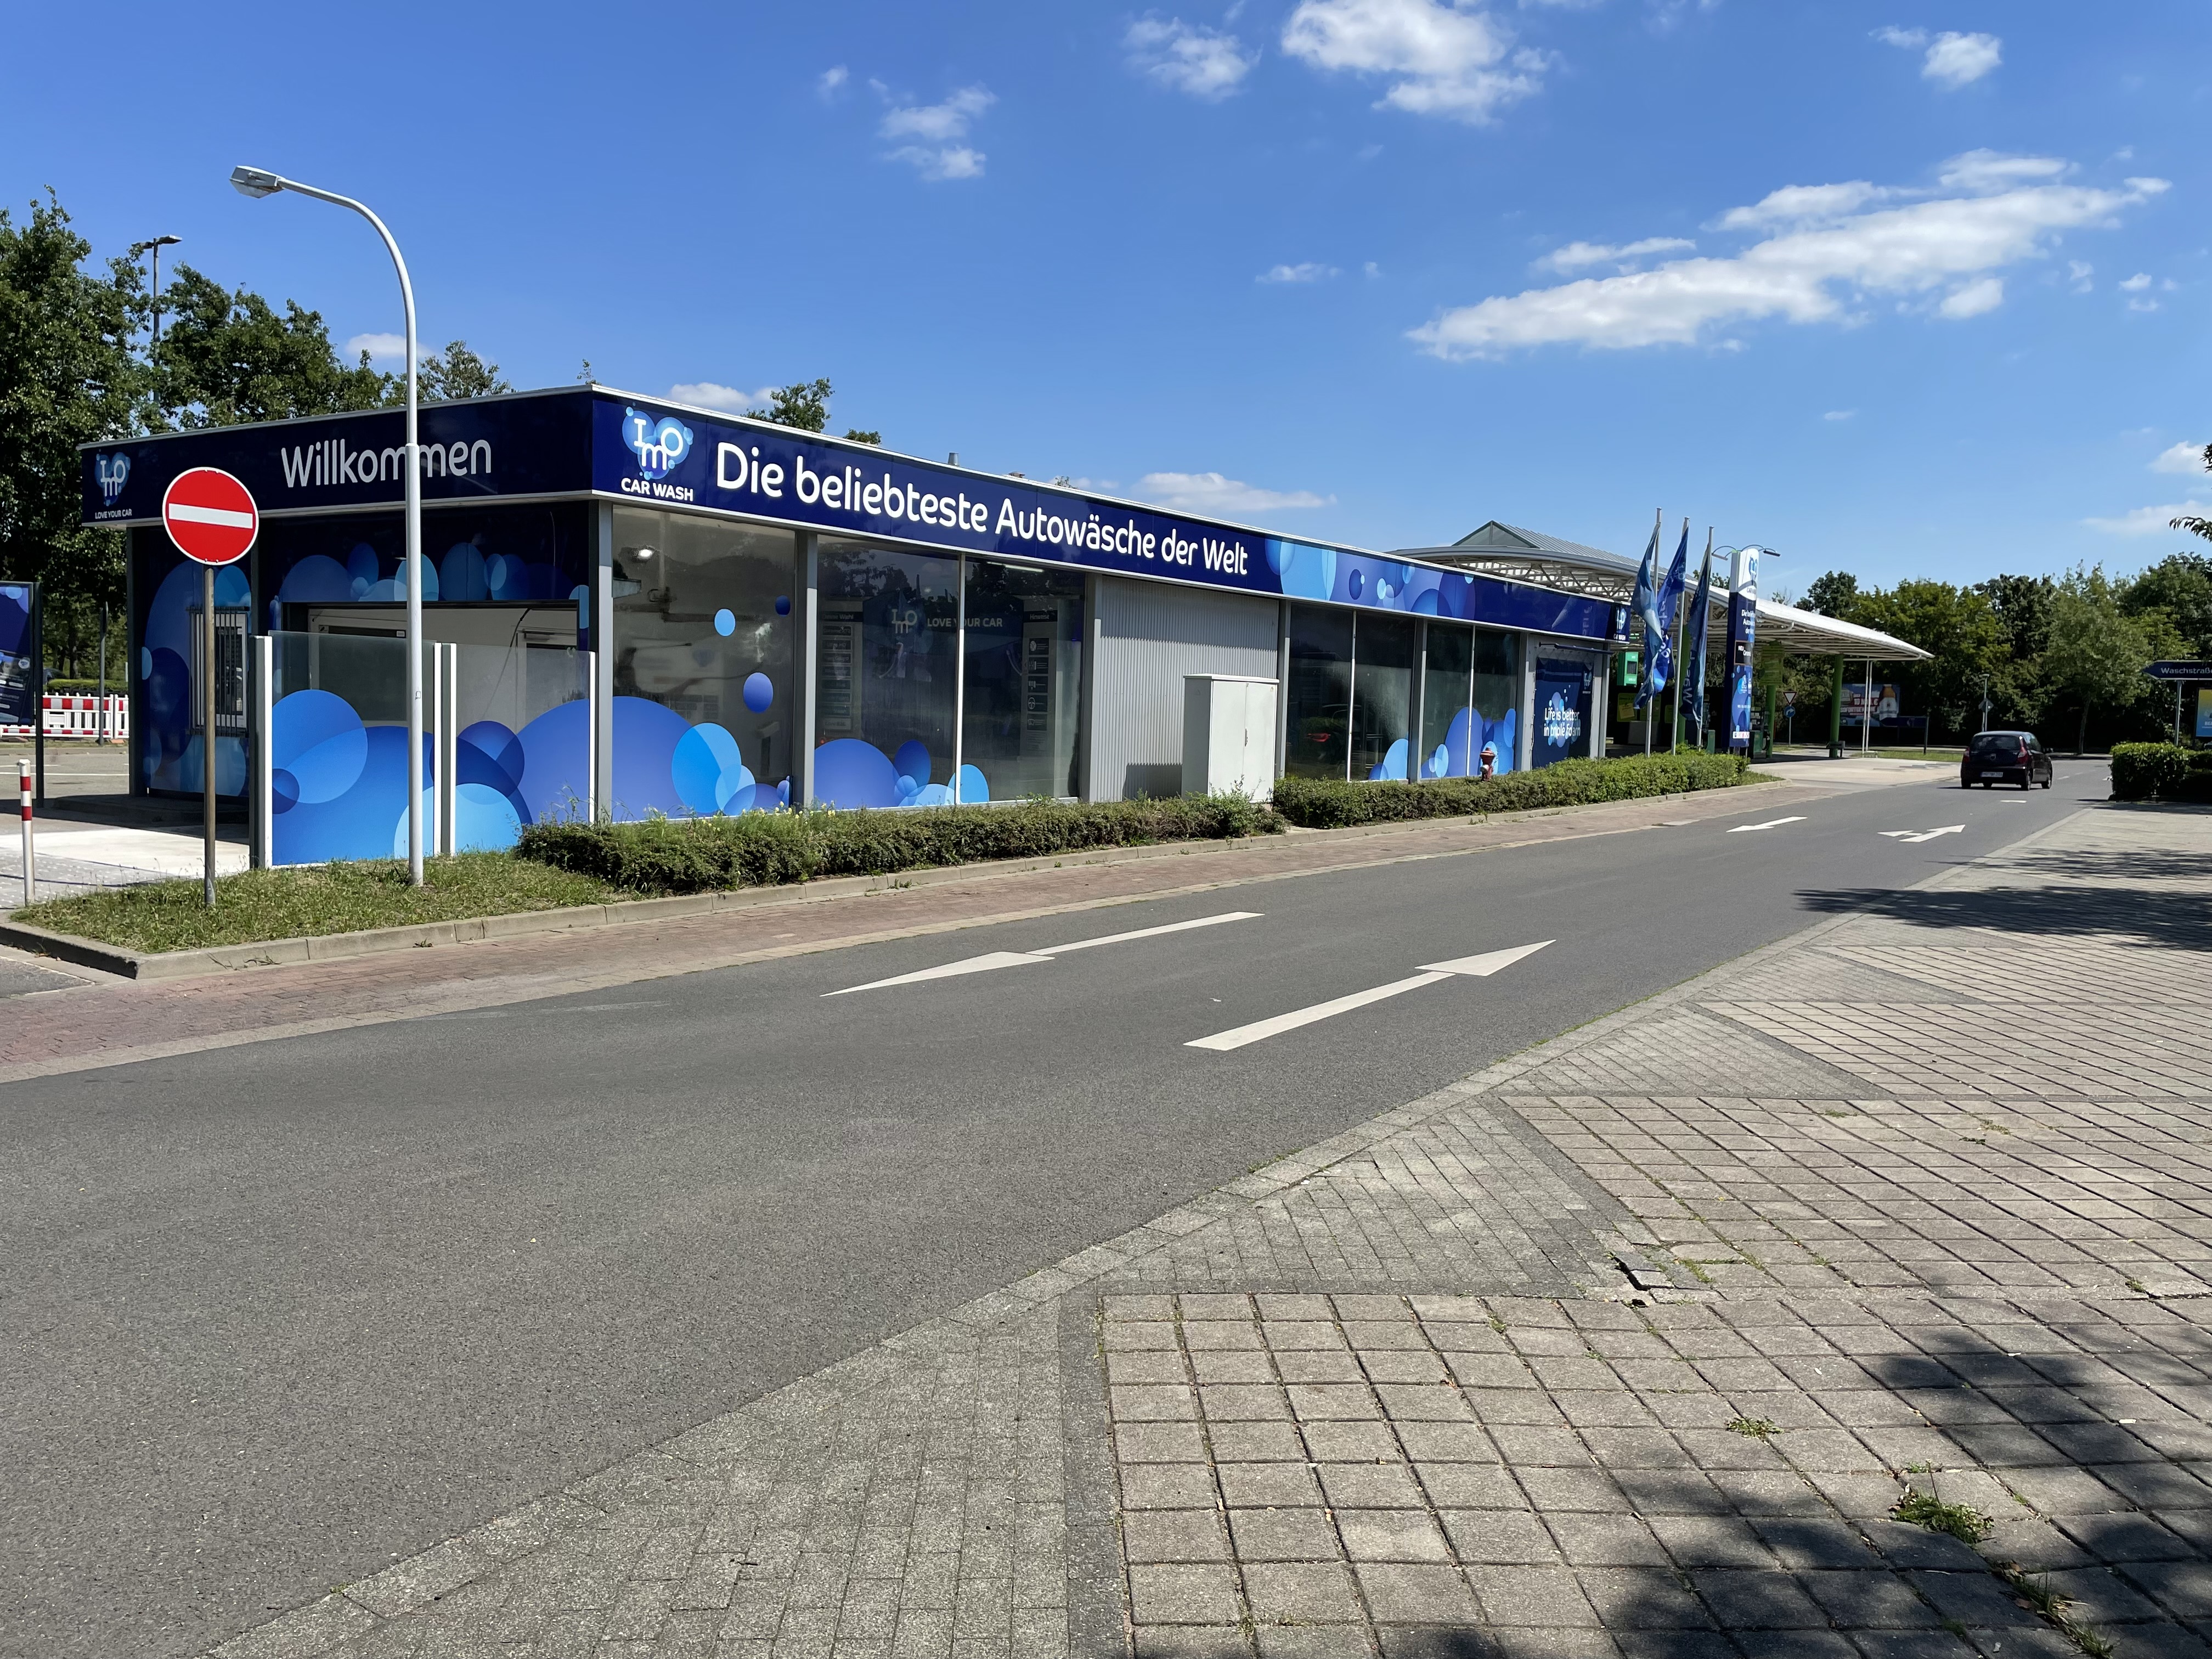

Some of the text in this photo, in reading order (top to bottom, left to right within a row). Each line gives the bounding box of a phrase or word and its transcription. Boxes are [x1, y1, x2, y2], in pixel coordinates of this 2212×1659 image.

[281, 438, 492, 488] Willkommen
[621, 477, 694, 502] CAR WASH
[94, 508, 132, 520] LOVE YOUR CAR
[716, 442, 1249, 575] Die beliebteste Autowäsche der Welt
[927, 618, 952, 627] LOVE
[983, 618, 1003, 627] CAR
[1544, 708, 1579, 721] Life is better
[1544, 722, 1581, 739] in triple foam
